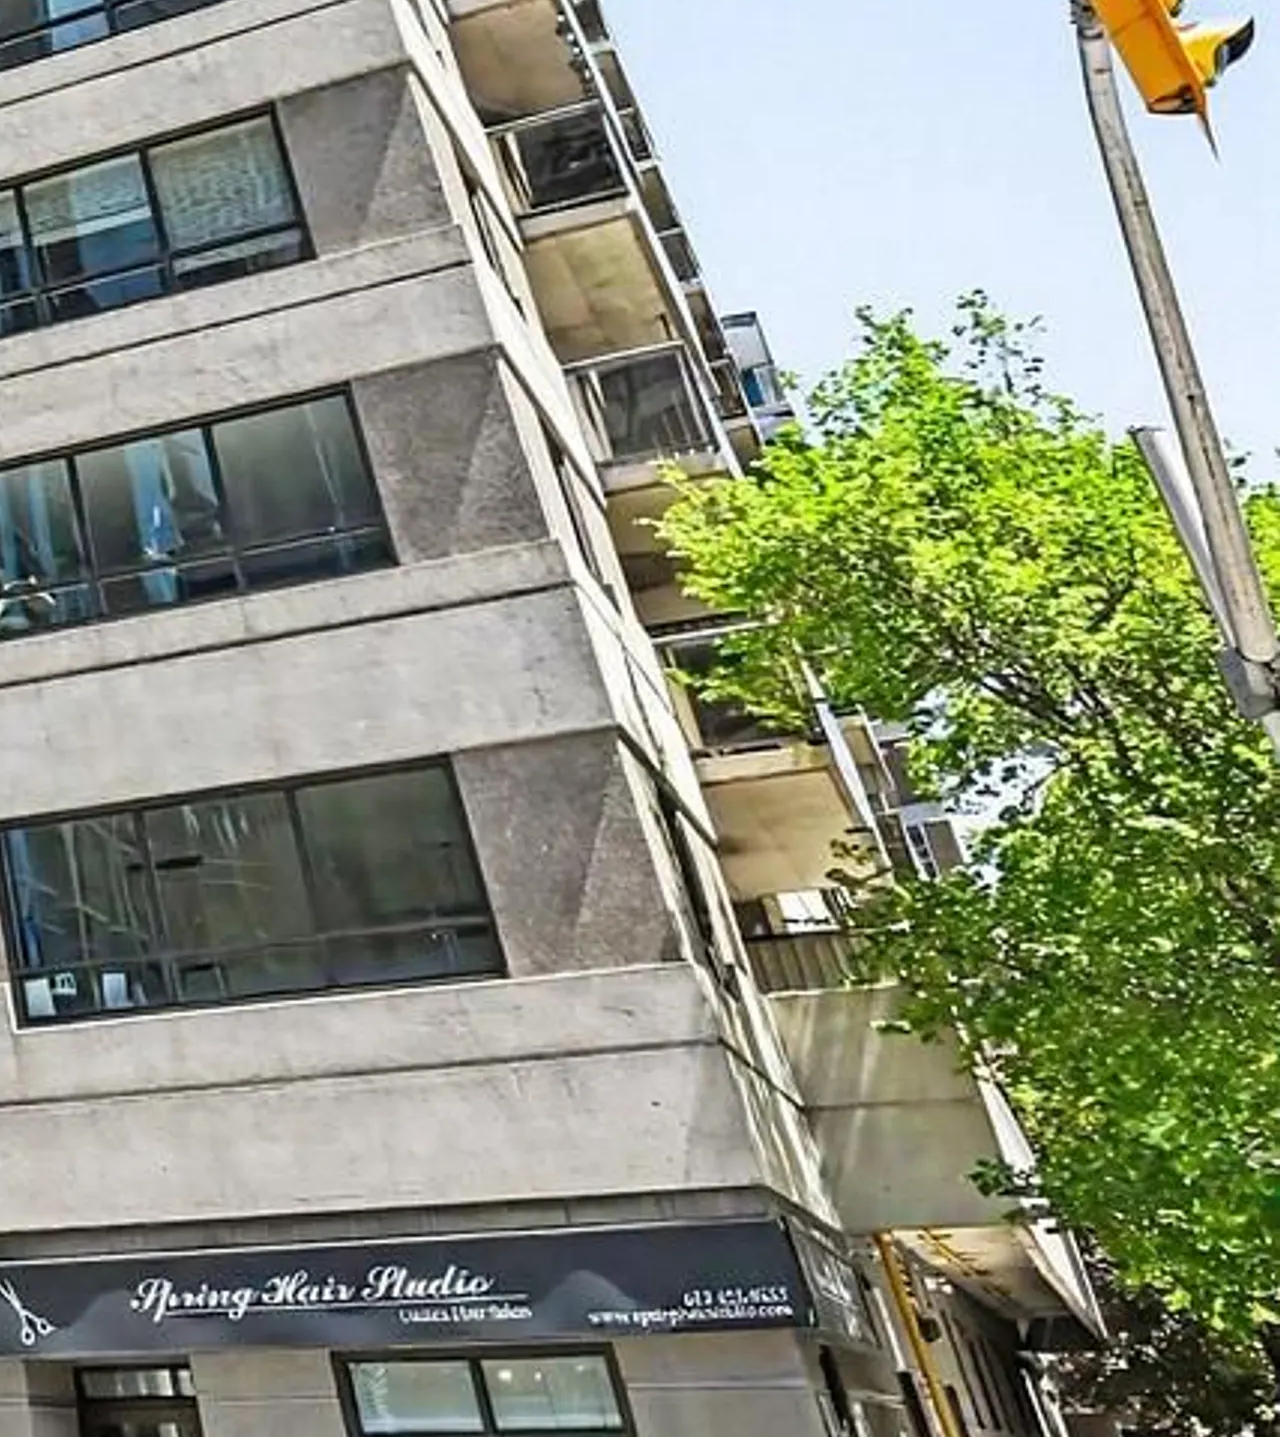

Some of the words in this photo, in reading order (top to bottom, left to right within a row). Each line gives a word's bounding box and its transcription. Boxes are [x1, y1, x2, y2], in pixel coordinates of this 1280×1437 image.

[130, 1277, 253, 1323] Spring
[262, 1271, 353, 1305] Hair
[360, 1263, 494, 1300] Studio
